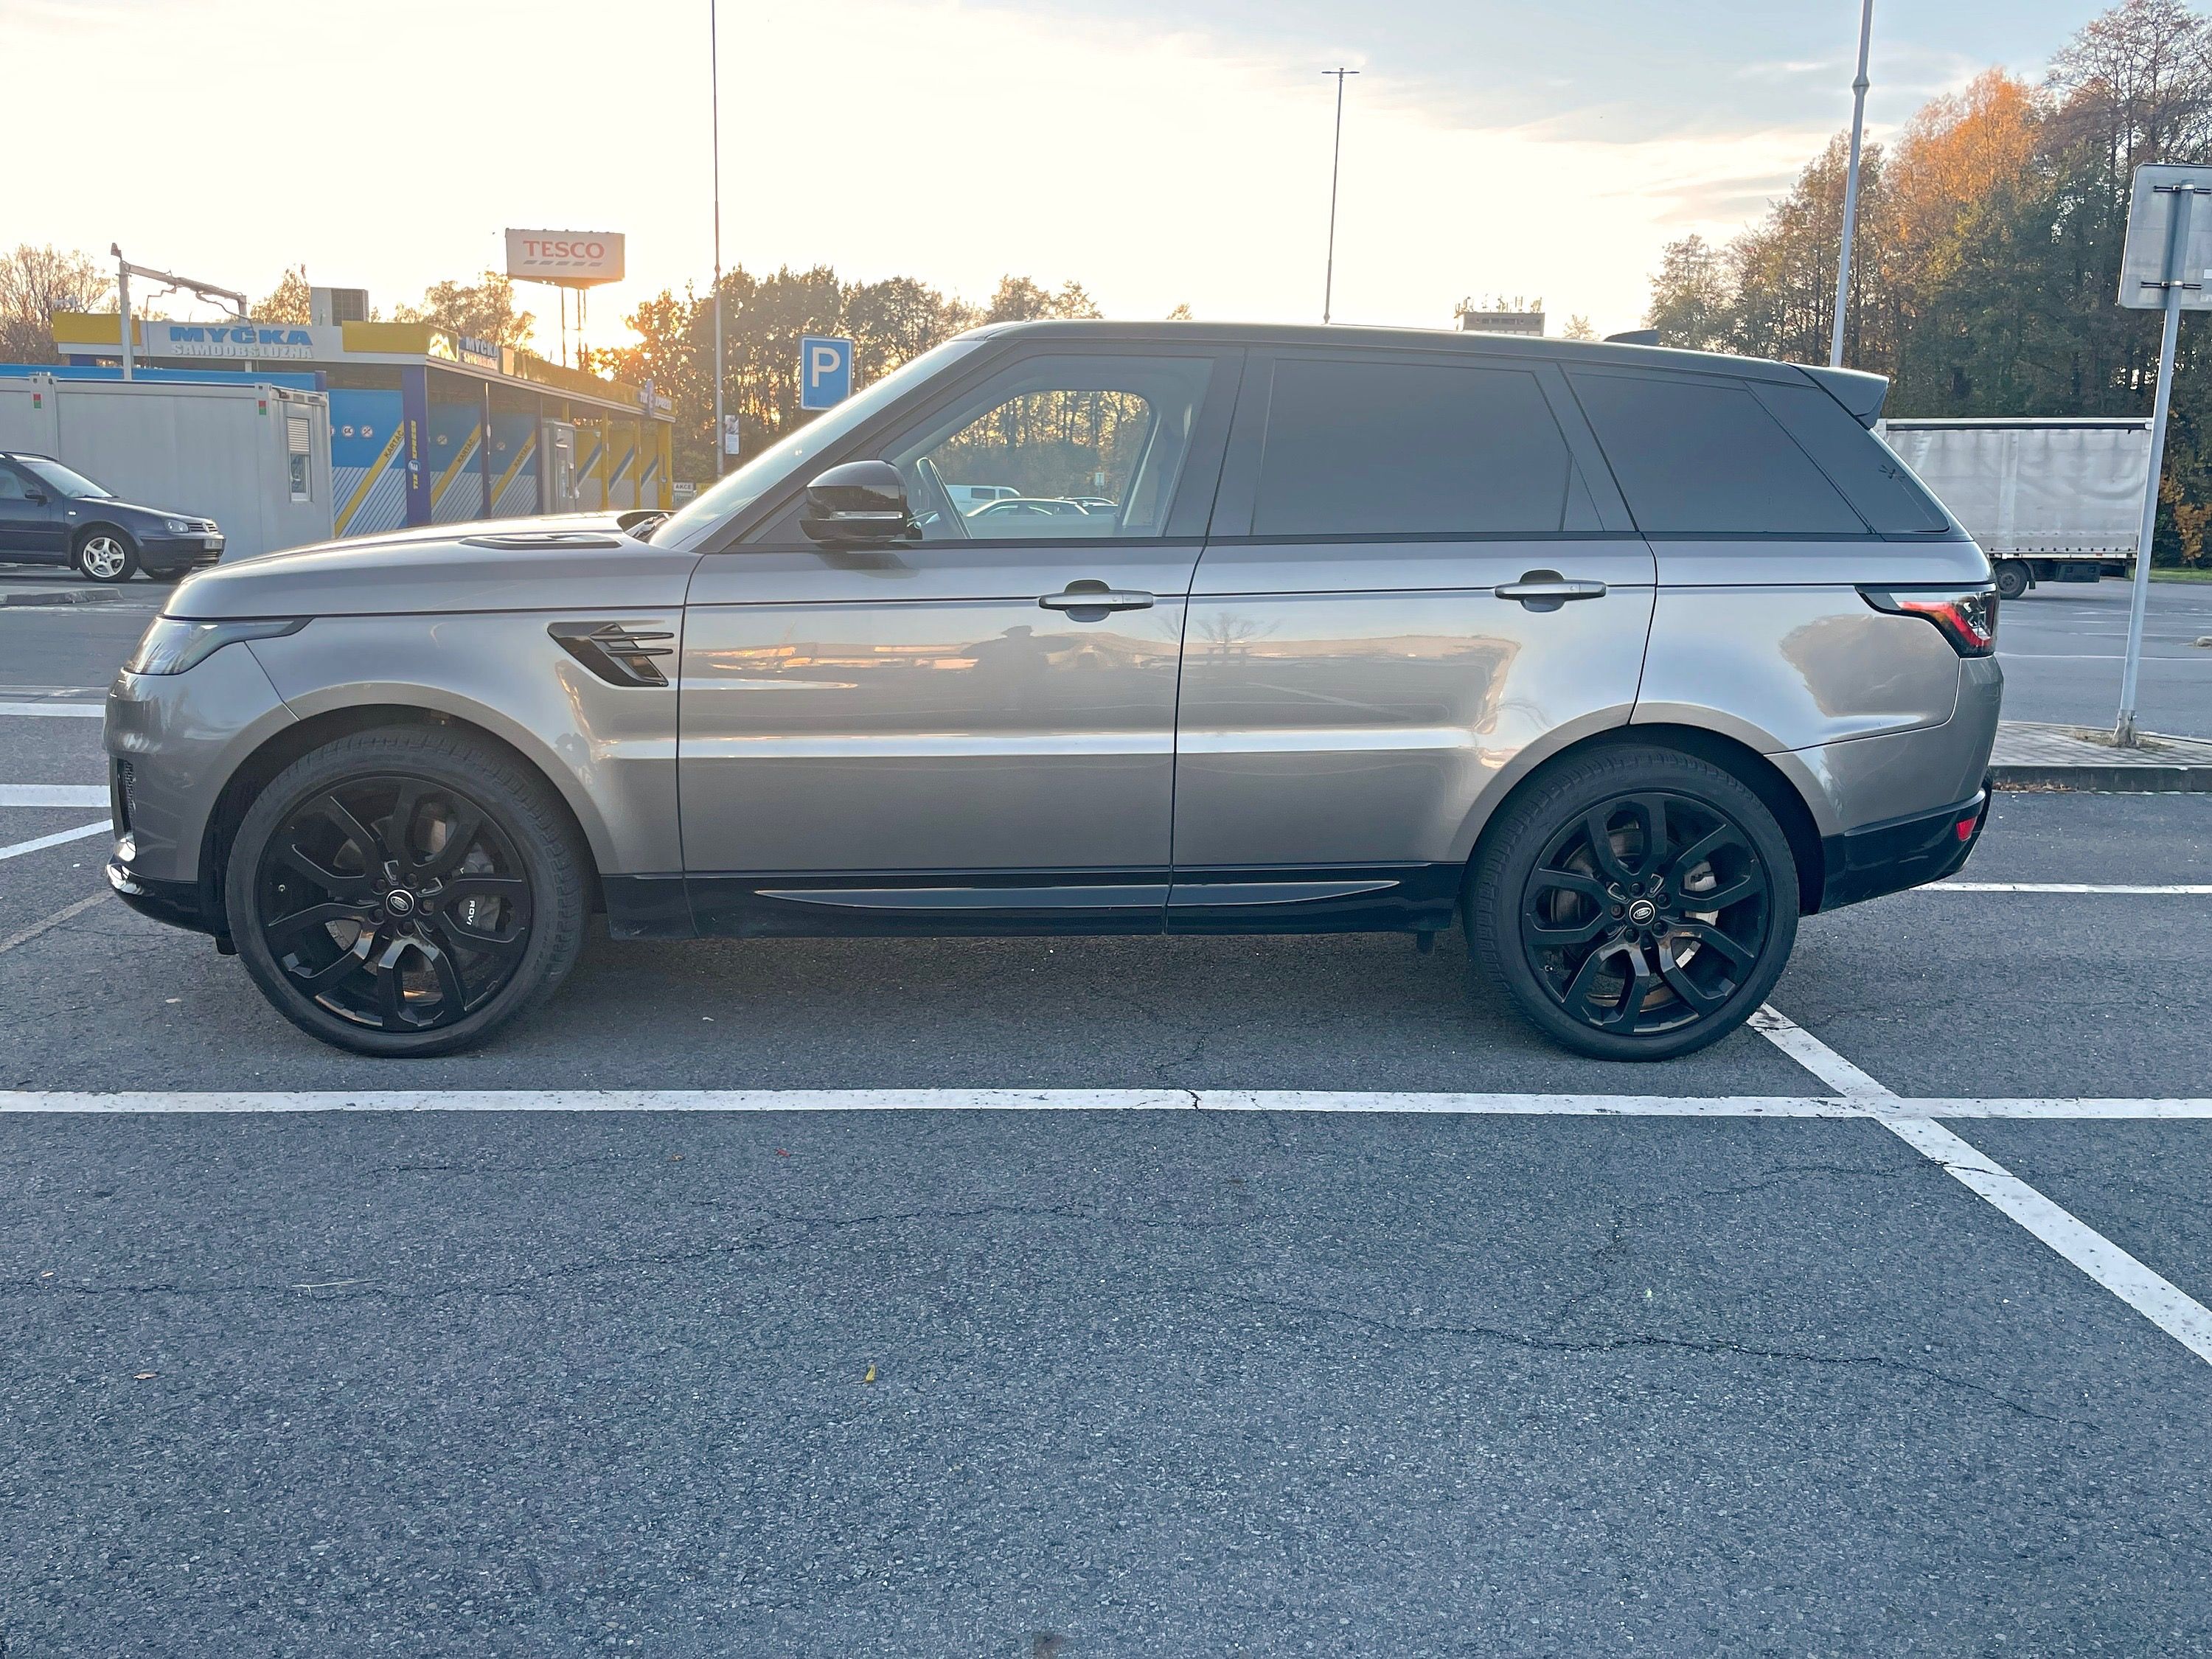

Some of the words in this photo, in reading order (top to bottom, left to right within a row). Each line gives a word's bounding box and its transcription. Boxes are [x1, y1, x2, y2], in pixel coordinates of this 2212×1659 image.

[523, 240, 605, 259] TESCO
[170, 325, 313, 346] MYČKA
[812, 347, 841, 387] P
